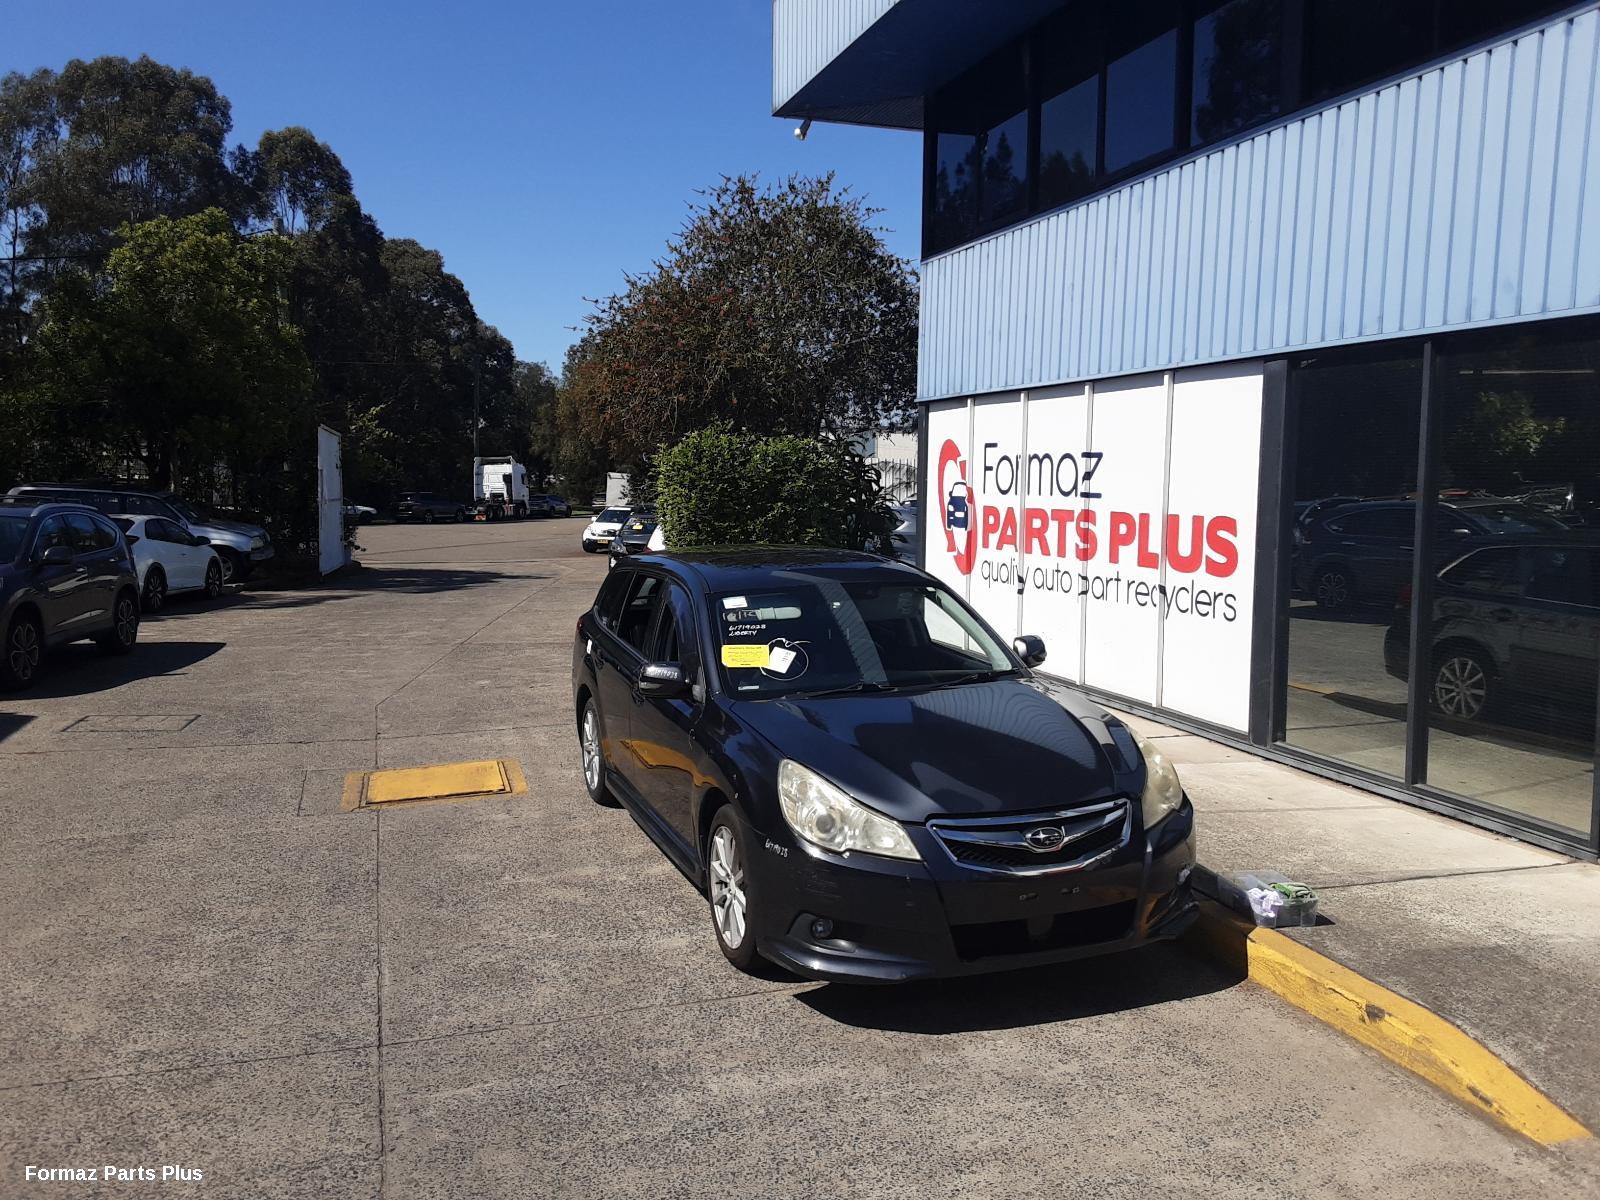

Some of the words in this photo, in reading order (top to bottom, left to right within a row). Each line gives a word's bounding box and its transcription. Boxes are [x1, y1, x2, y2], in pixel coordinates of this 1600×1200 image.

[983, 442, 1104, 499] Formaz
[982, 505, 1098, 561] PARTS
[1109, 511, 1239, 578] PLUS
[981, 556, 1030, 595] qualiy
[1033, 563, 1073, 594] auto
[1077, 570, 1122, 604] part
[1127, 579, 1238, 623] recyclers
